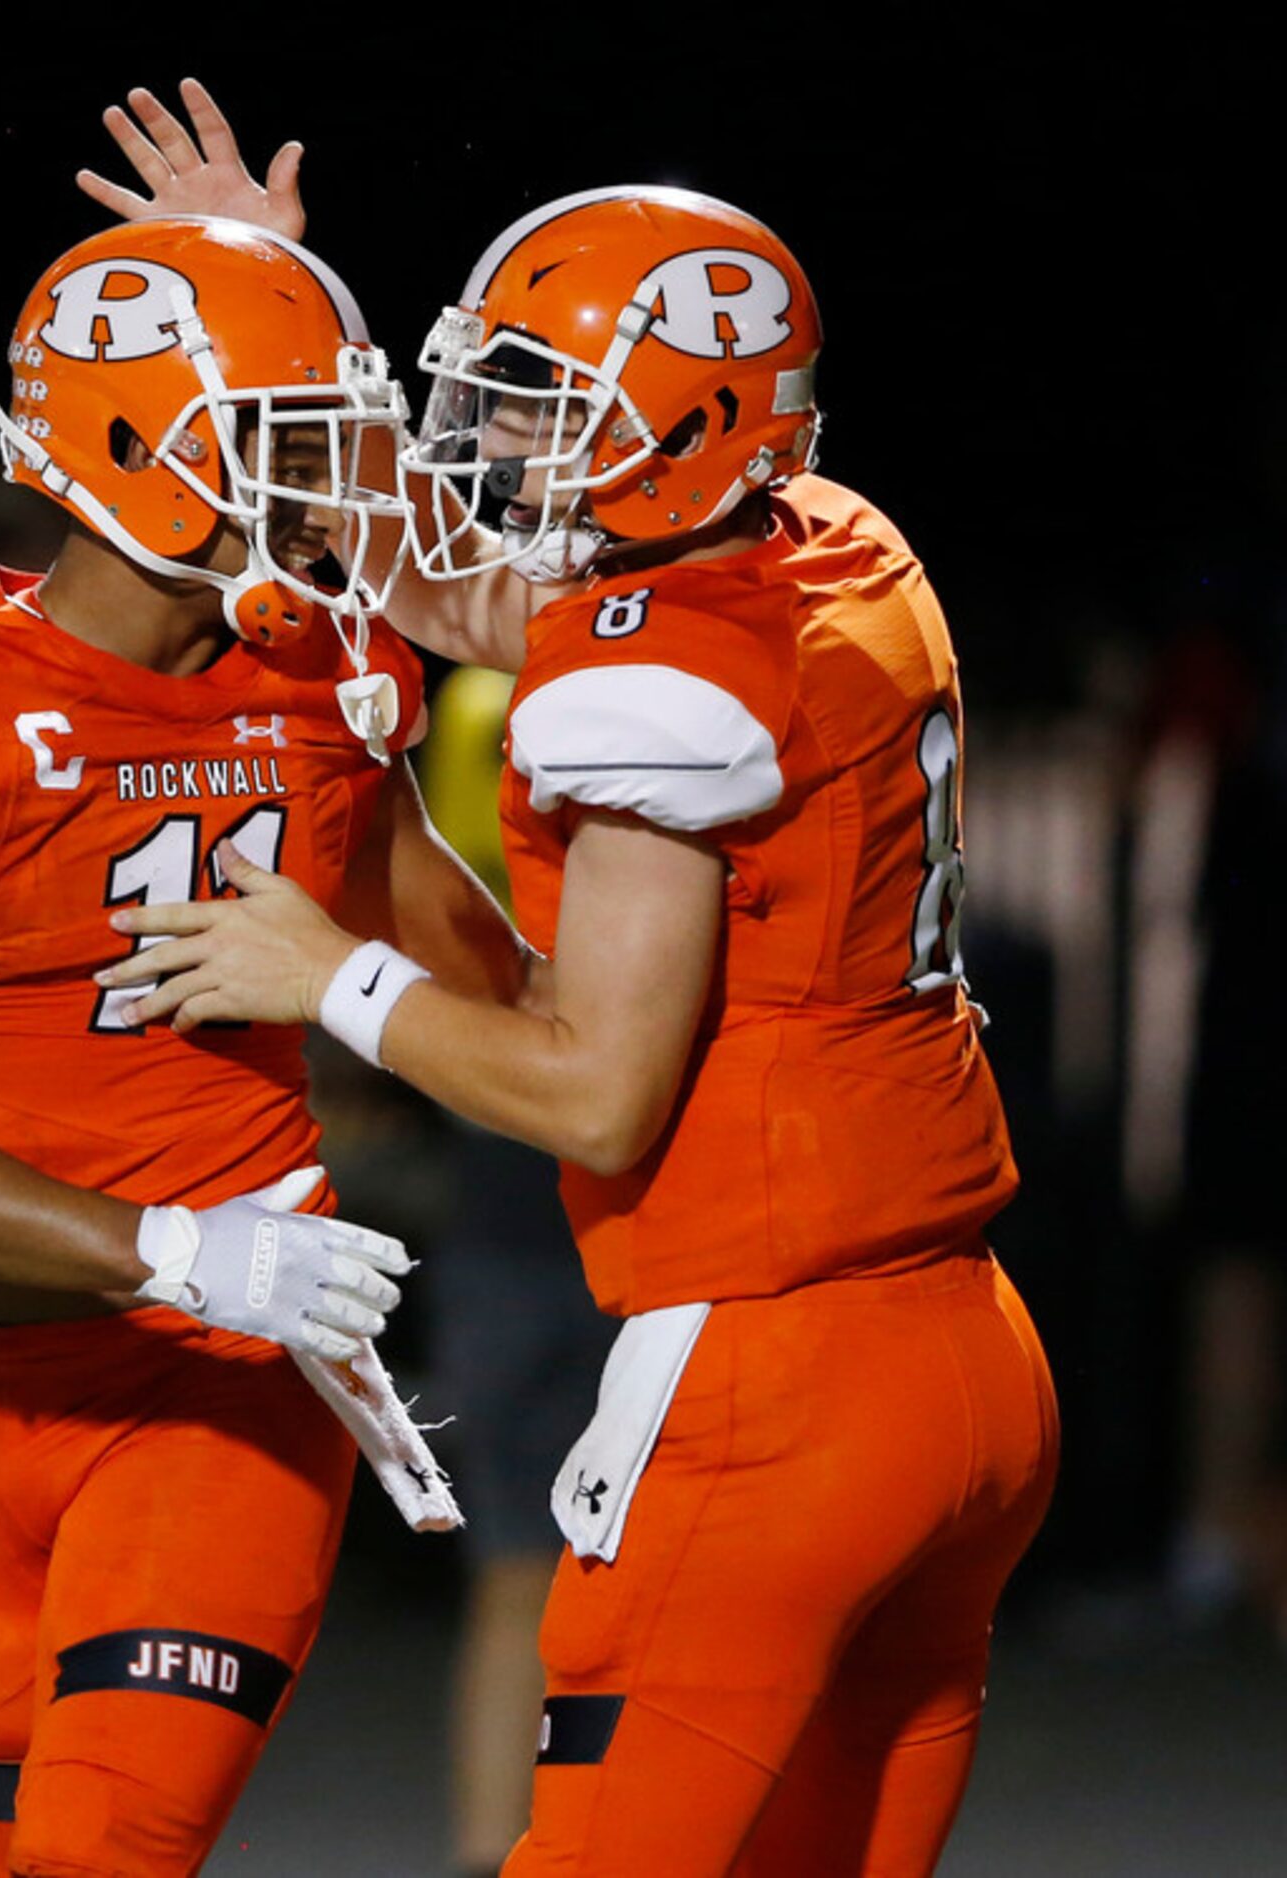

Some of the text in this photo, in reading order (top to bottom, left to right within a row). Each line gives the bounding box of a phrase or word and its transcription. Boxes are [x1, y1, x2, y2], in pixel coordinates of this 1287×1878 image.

[38, 256, 198, 362] R
[642, 246, 795, 360] R
[592, 587, 654, 639] 8
[14, 710, 87, 790] C
[117, 756, 288, 801] ROCKWALL
[128, 1641, 240, 1695] JFND
